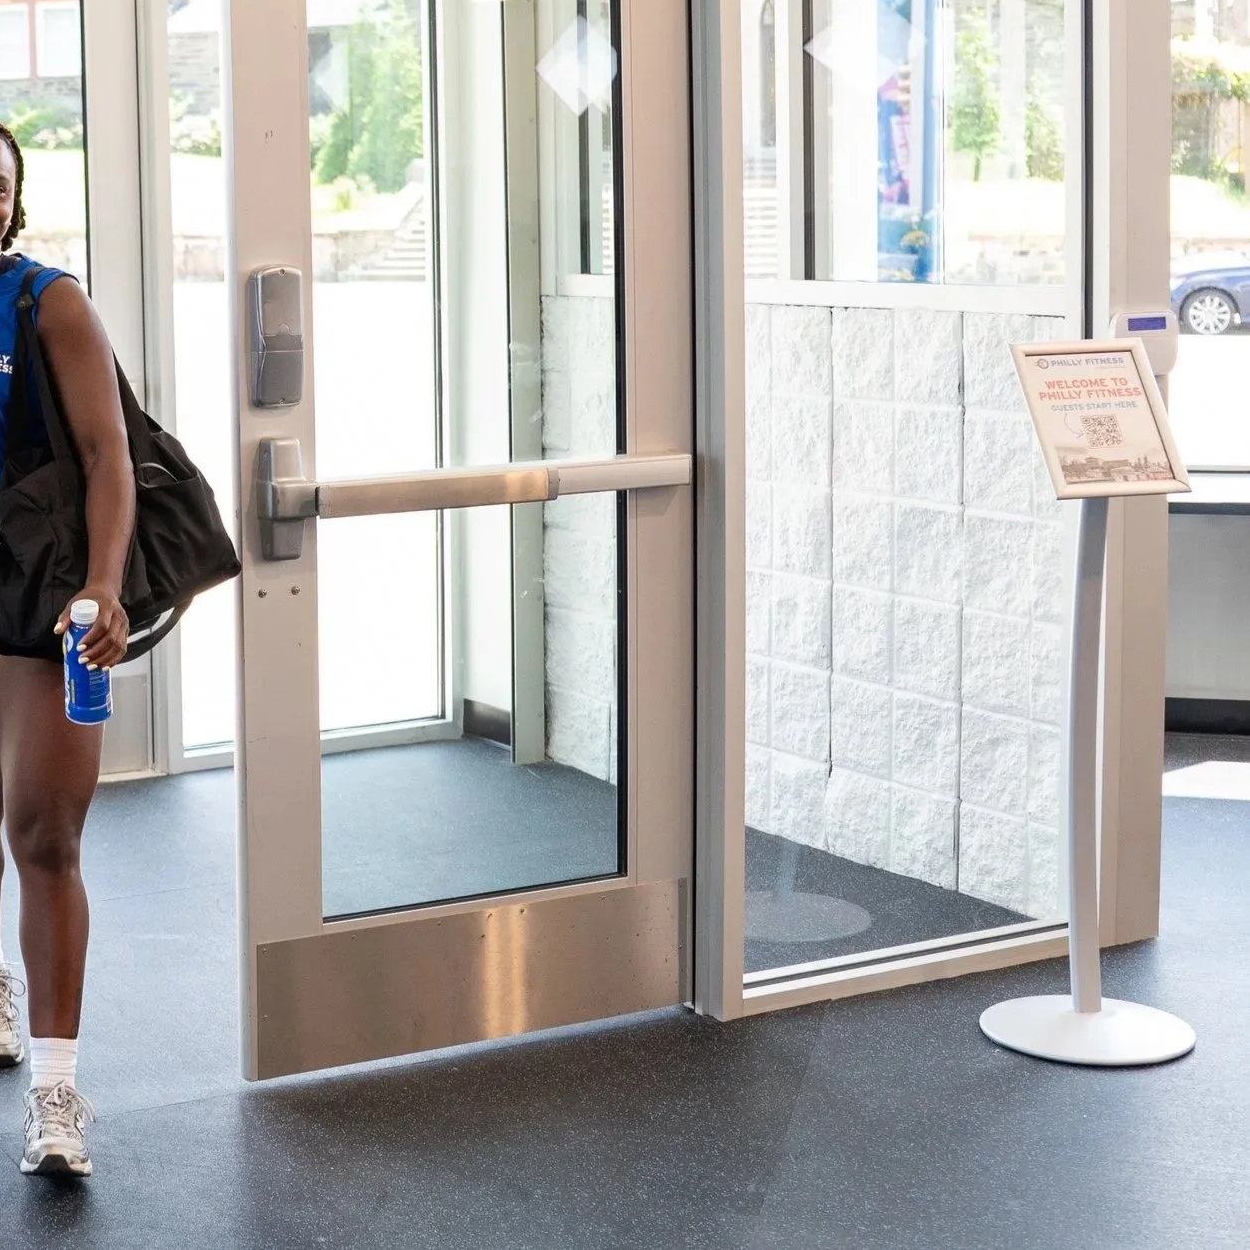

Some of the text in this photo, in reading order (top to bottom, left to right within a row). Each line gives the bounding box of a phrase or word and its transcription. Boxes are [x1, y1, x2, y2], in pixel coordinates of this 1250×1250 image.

[1051, 357, 1124, 367] PHILLY FITNESS
[1045, 377, 1128, 390] WELCOME TO
[1039, 387, 1142, 401] PHILLY FITNESS
[1051, 401, 1138, 411] GUESTS START HERE
